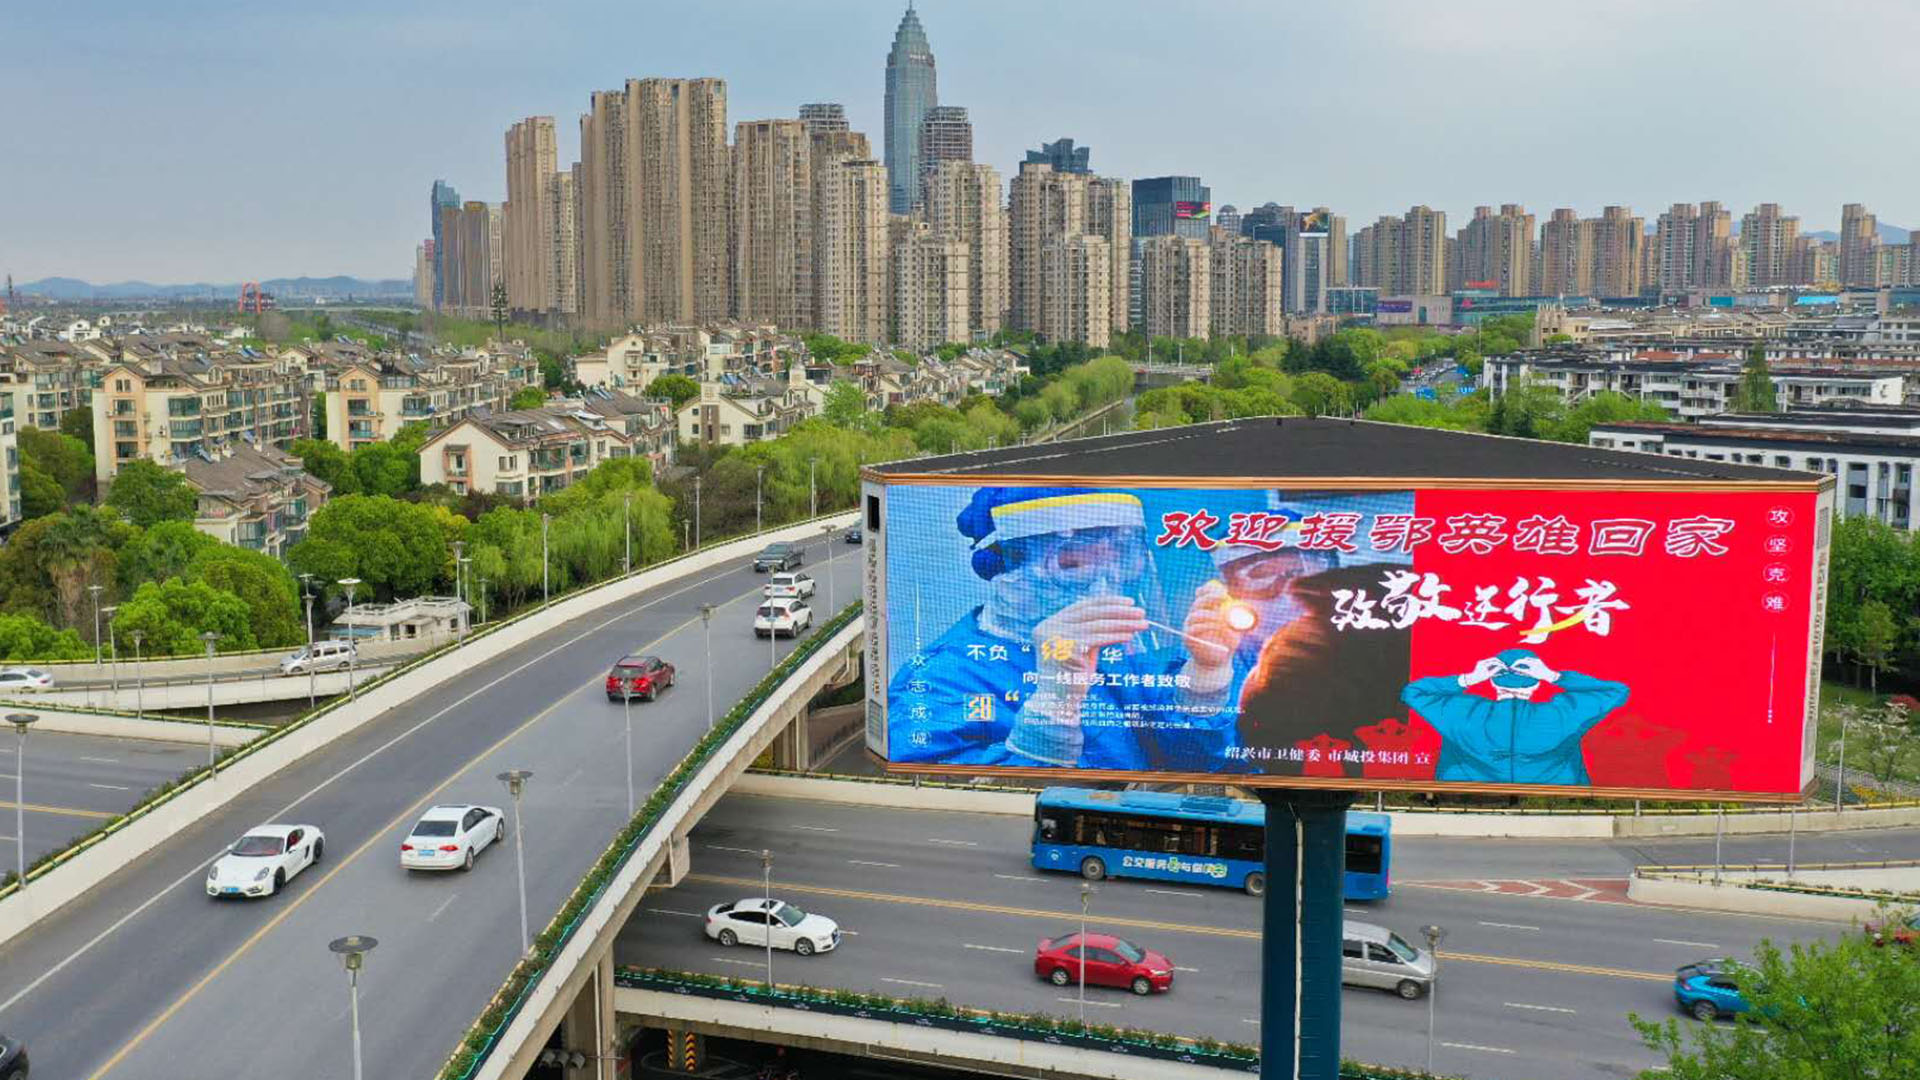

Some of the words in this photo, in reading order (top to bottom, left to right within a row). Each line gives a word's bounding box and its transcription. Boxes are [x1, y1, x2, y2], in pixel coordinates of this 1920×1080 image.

[1156, 509, 1736, 557] 欢迎援鄂英雄回家
[1766, 509, 1789, 611] 攻坚克难
[1330, 571, 1631, 643] 致敬逆行者
[1022, 671, 1191, 689] 向一线医务工作者致敬
[1224, 746, 1322, 763] 绍兴市卫健委
[1328, 749, 1409, 765] 市城投集团
[1415, 752, 1431, 765] 宣
